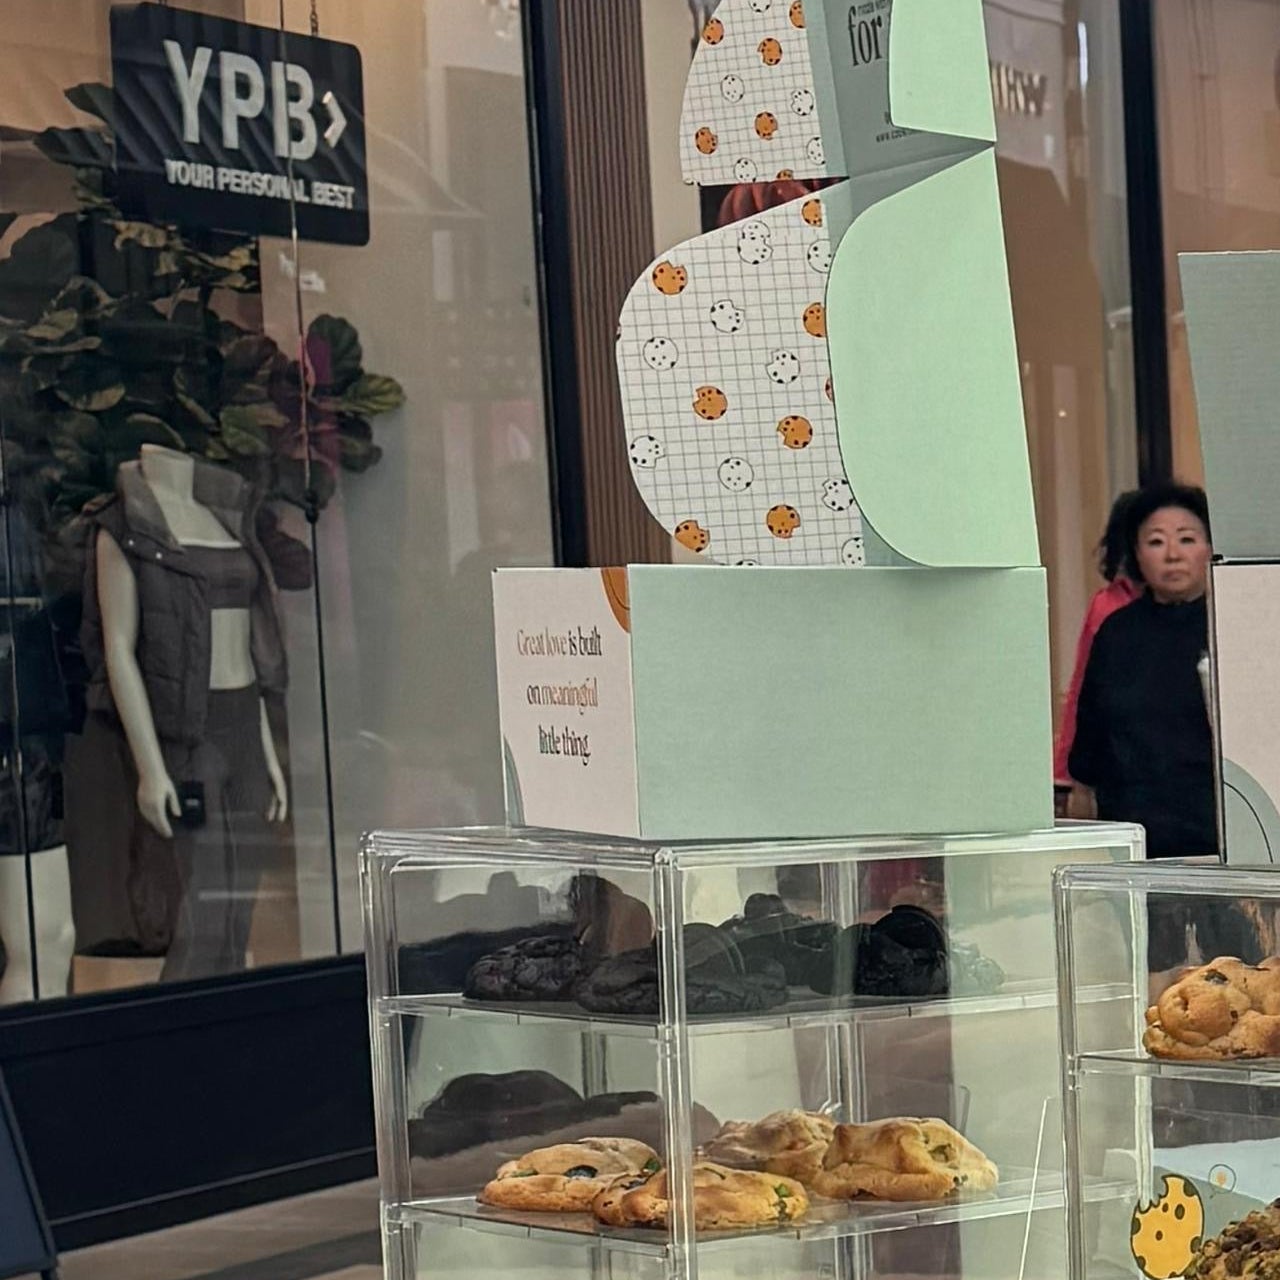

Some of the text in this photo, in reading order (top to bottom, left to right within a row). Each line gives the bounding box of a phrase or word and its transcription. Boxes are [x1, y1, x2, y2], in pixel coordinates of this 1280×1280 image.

[847, 6, 883, 67] for
[163, 39, 318, 161] YPB
[165, 158, 214, 191] YOUR
[311, 180, 355, 209] BEST
[517, 625, 602, 657] Great love is built
[526, 677, 599, 716] on meaningful
[537, 724, 561, 755] little
